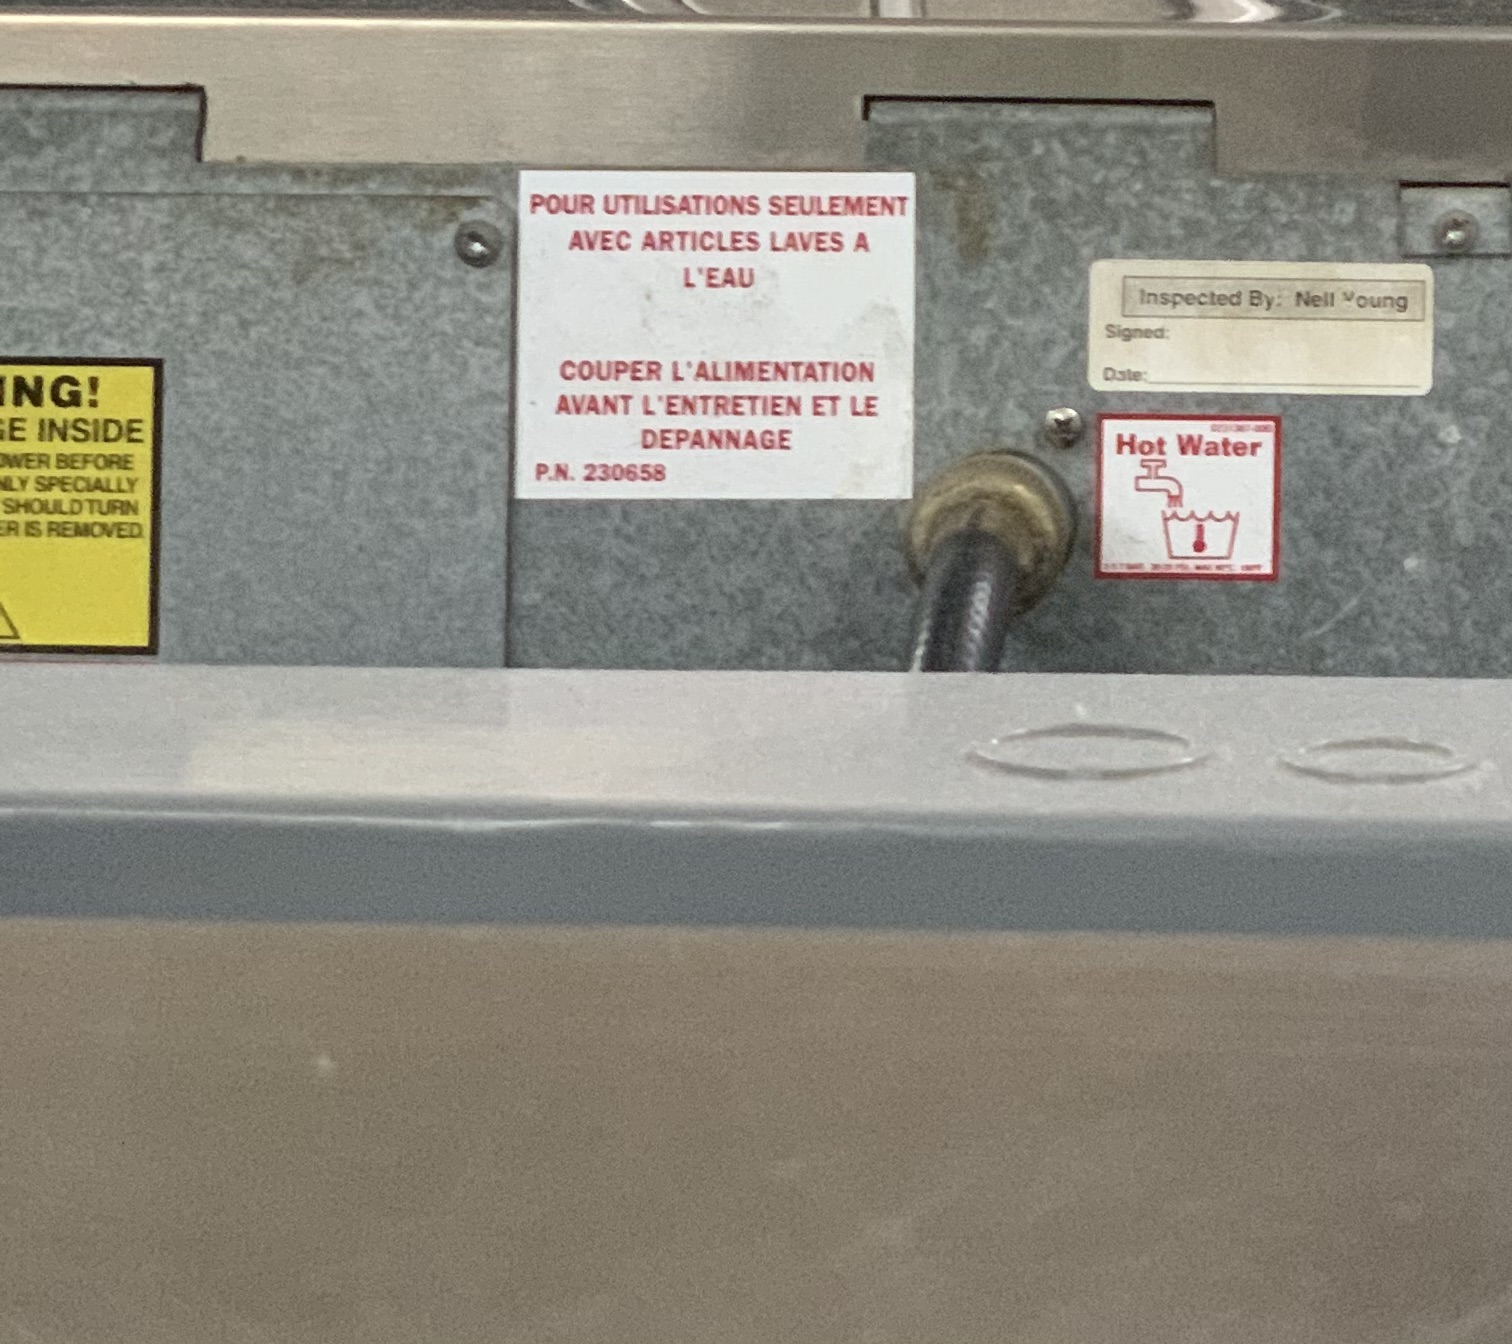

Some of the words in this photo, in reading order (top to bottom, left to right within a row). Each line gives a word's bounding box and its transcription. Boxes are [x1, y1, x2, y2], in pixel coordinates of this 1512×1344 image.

[529, 193, 596, 216] POUR
[602, 194, 761, 217] UTILISATIONS
[767, 195, 909, 217] SEULEMENT
[568, 229, 632, 252] AVEC
[641, 230, 761, 253] ARTICLES
[769, 230, 844, 253] LAVES
[852, 231, 871, 253] A
[683, 266, 755, 289] L'EAU
[1138, 287, 1243, 310] Inspected
[1248, 289, 1283, 312] By:
[1342, 291, 1410, 314] Young
[1104, 323, 1171, 343] Signed:
[558, 359, 663, 382] COUPER
[671, 360, 876, 384] L'ALIMENTATION
[1102, 366, 1149, 383] Date:
[554, 393, 634, 416] AVANT
[642, 394, 802, 417] L'ENTRETIEN
[812, 395, 841, 417] ET
[850, 395, 879, 418] LE
[38, 417, 145, 444] INSIDE
[640, 428, 793, 451] DEPANNAGE
[1115, 432, 1168, 456] Hot
[1176, 433, 1263, 458] Water
[55, 453, 135, 471] BEFORE
[535, 462, 575, 482] P.N.
[582, 462, 667, 483] 230658
[34, 475, 140, 494] SPECIALLY
[2, 497, 83, 516] SHOULD
[84, 498, 140, 516] TURN
[24, 520, 42, 538] IS
